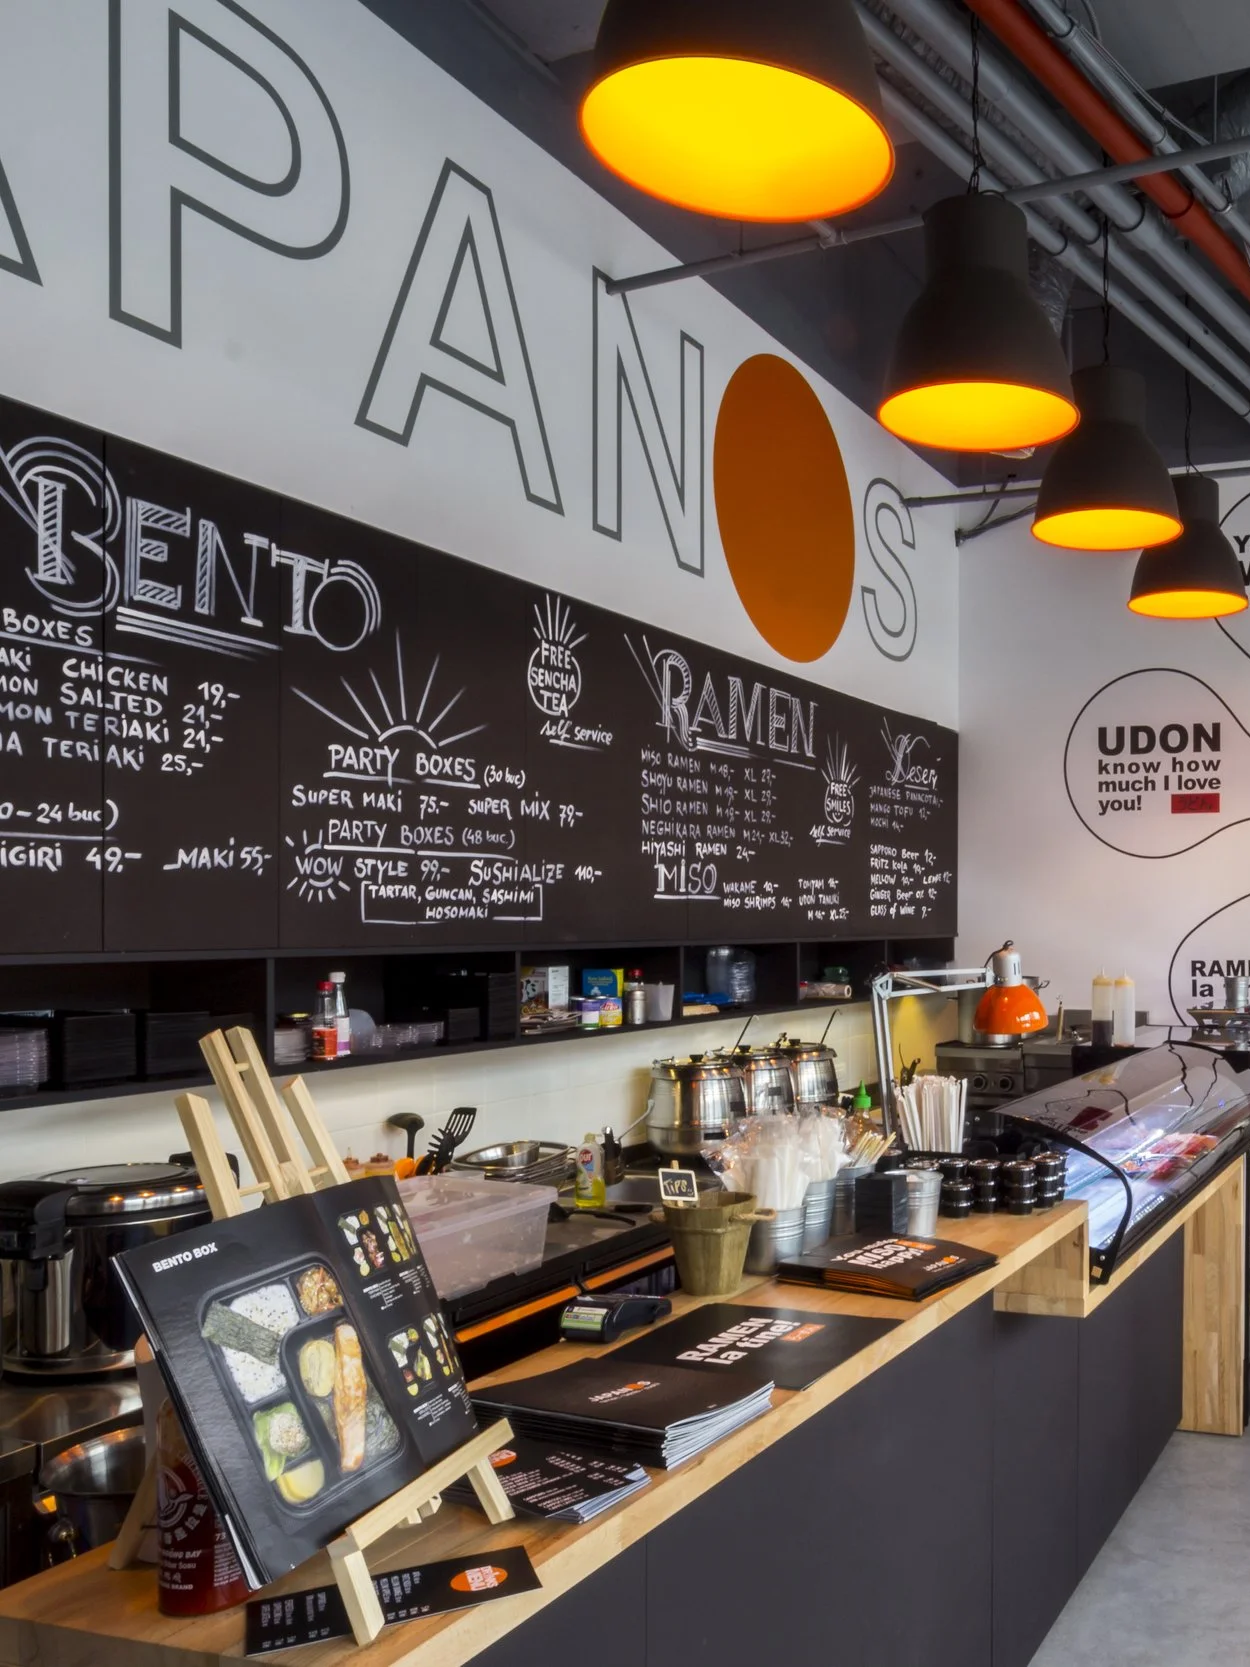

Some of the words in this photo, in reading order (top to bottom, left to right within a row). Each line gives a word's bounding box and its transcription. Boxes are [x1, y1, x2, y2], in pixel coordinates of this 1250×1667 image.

[2, 607, 94, 647] BOXES
[541, 639, 571, 669] FREE
[530, 667, 577, 692] SENCHA
[60, 682, 162, 716] SALTED
[540, 690, 568, 717] TEA
[636, 648, 820, 758] RAMEN
[574, 724, 613, 745] service
[1097, 722, 1222, 756] UDON
[328, 744, 400, 787] PARTY
[416, 752, 476, 782] BOXES
[667, 752, 700, 773] RAMEN
[744, 768, 757, 783] XL
[1098, 758, 1161, 775] know
[1171, 756, 1221, 773] how
[676, 776, 708, 794] RAMEN
[744, 789, 758, 803] XL
[830, 781, 848, 797] FREE
[1098, 775, 1156, 793] much
[1163, 775, 1170, 791] I
[1177, 773, 1221, 791] love
[676, 801, 708, 816] RAMEN
[744, 810, 757, 823] XL
[870, 803, 891, 815] MANGO
[893, 804, 914, 818] TOFU
[1097, 795, 1142, 815] you!
[328, 819, 388, 848] PARTY
[400, 824, 454, 846] BOXES
[706, 825, 736, 839] RAMEN
[695, 842, 727, 859] RAMEN
[296, 856, 343, 876] WOW
[354, 858, 408, 884] STYLE
[723, 880, 757, 894] WAKAME
[1191, 979, 1214, 997] la
[151, 1251, 193, 1273] BENTO
[192, 1242, 218, 1259] BOX
[847, 1244, 907, 1266] MISO
[676, 1317, 774, 1361] RAMEN
[704, 1350, 748, 1365] la
[736, 1319, 801, 1349] tine!
